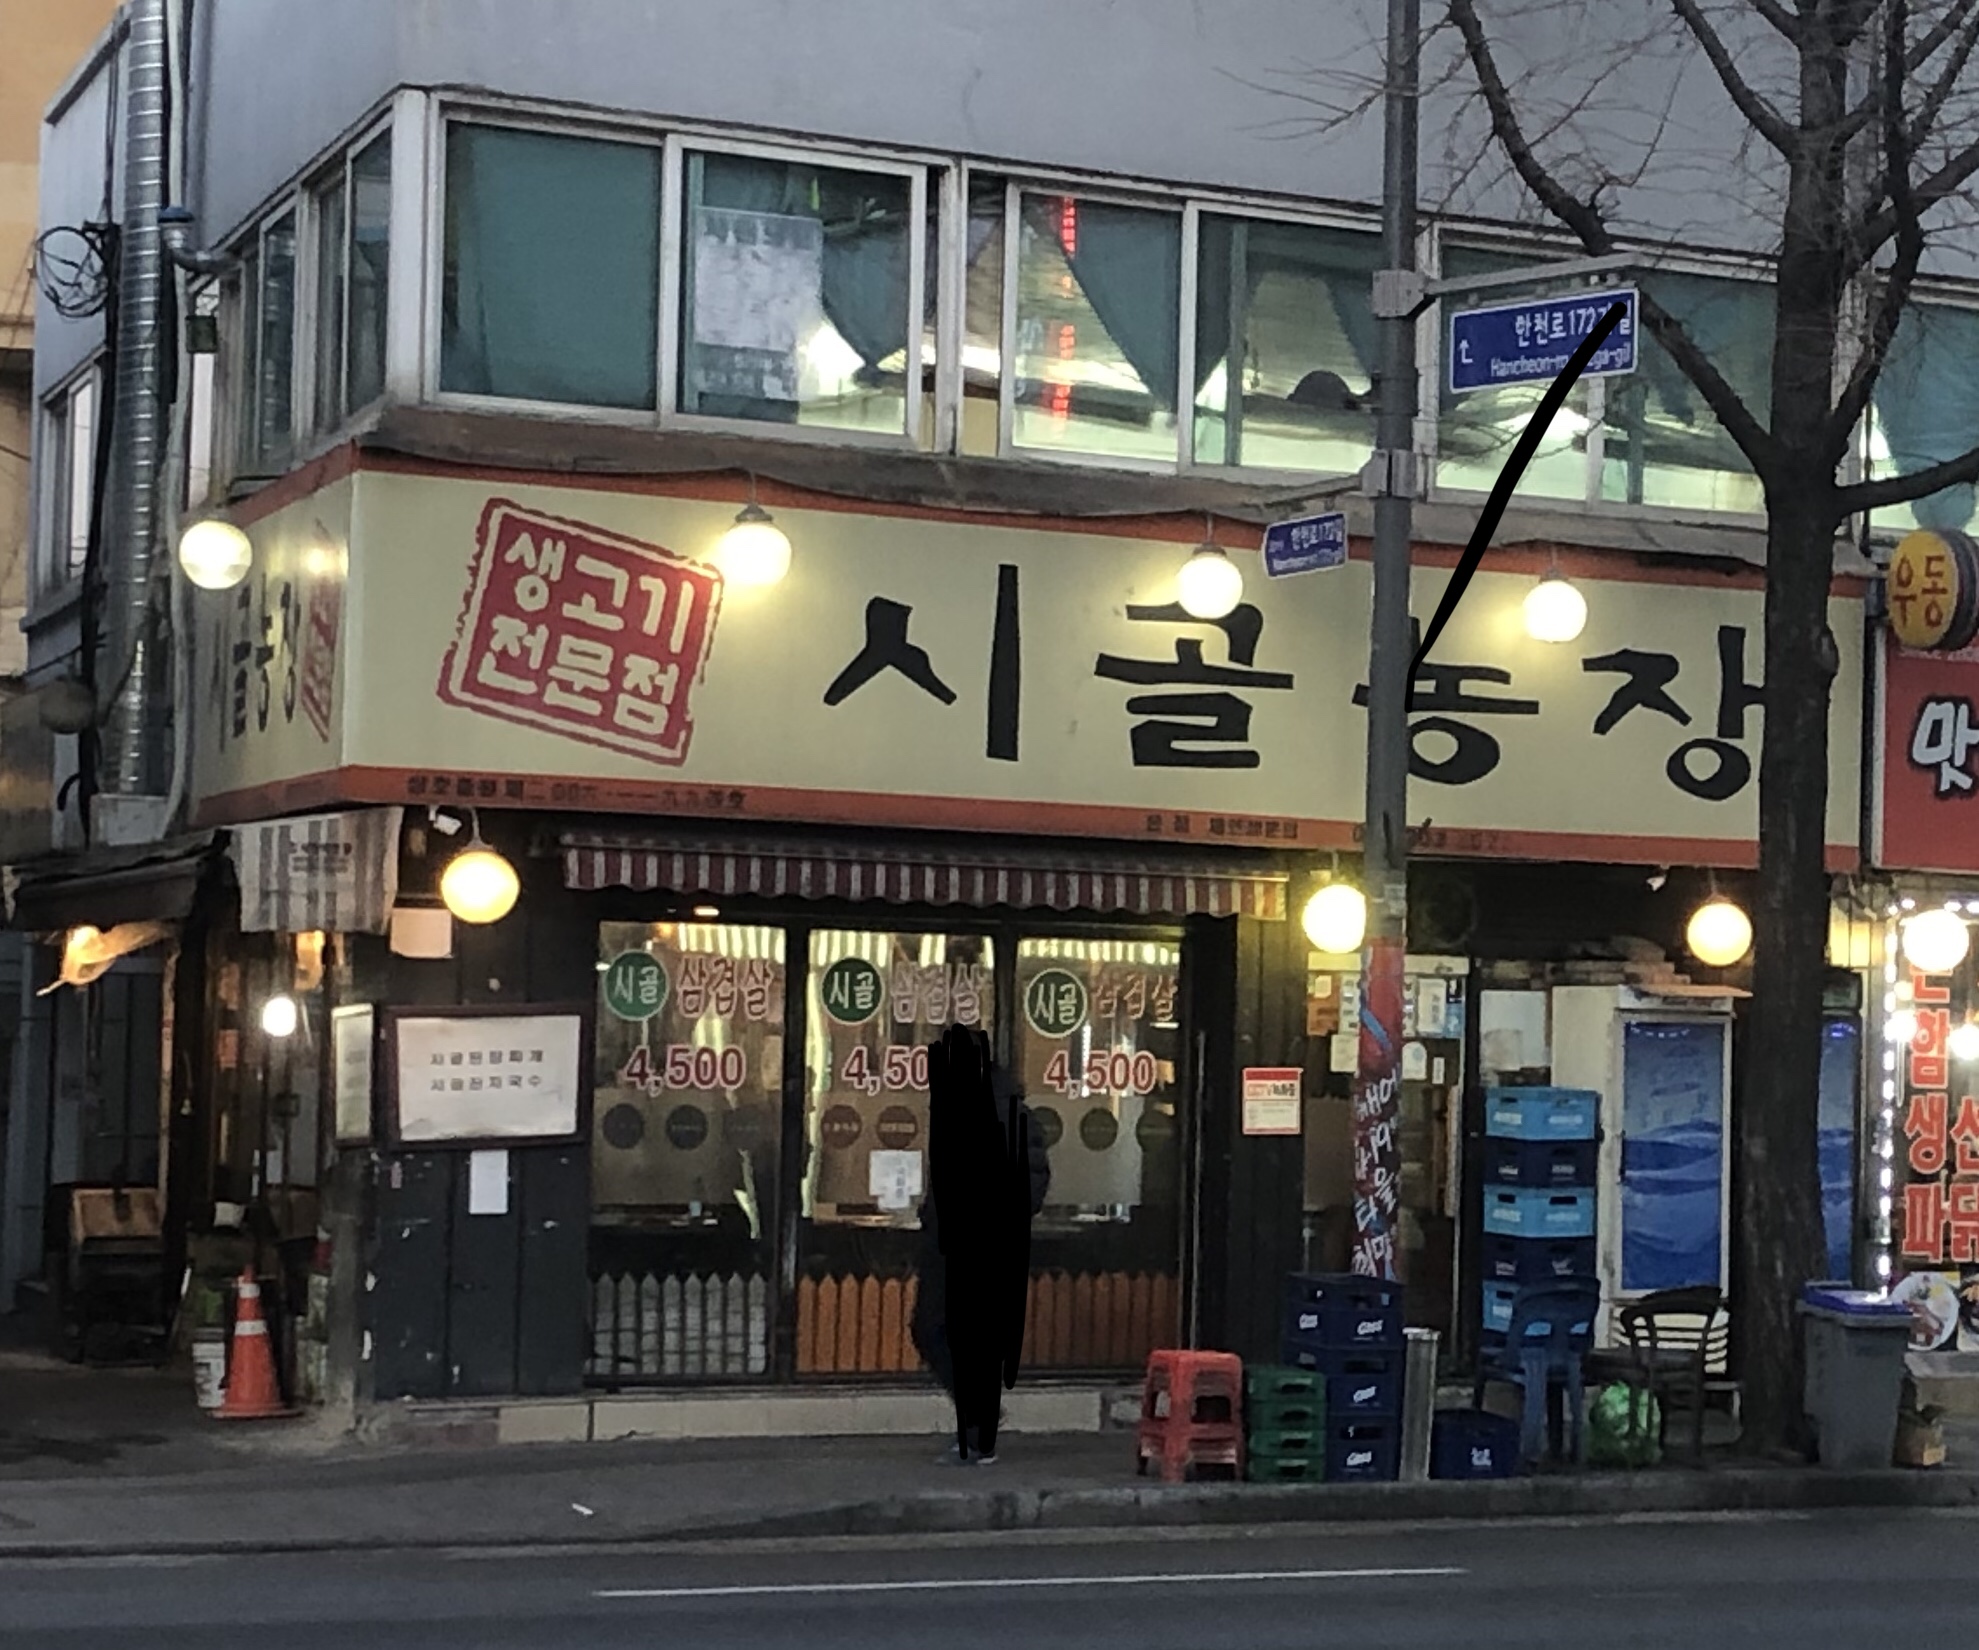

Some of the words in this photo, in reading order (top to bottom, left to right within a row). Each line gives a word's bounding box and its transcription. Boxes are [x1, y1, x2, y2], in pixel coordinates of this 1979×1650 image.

[505, 532, 695, 653] 생고기
[1892, 554, 1948, 627] 우동
[477, 614, 679, 736] 전문점
[1912, 701, 1979, 791] 맛
[614, 965, 659, 1005] 시골
[677, 956, 772, 1021] 삼겹살
[829, 971, 874, 1011] 시골
[1034, 983, 1077, 1025] 시골
[625, 1045, 746, 1097] 4,500
[842, 1045, 930, 1096] 4,50
[1043, 1050, 1157, 1100] 4,500
